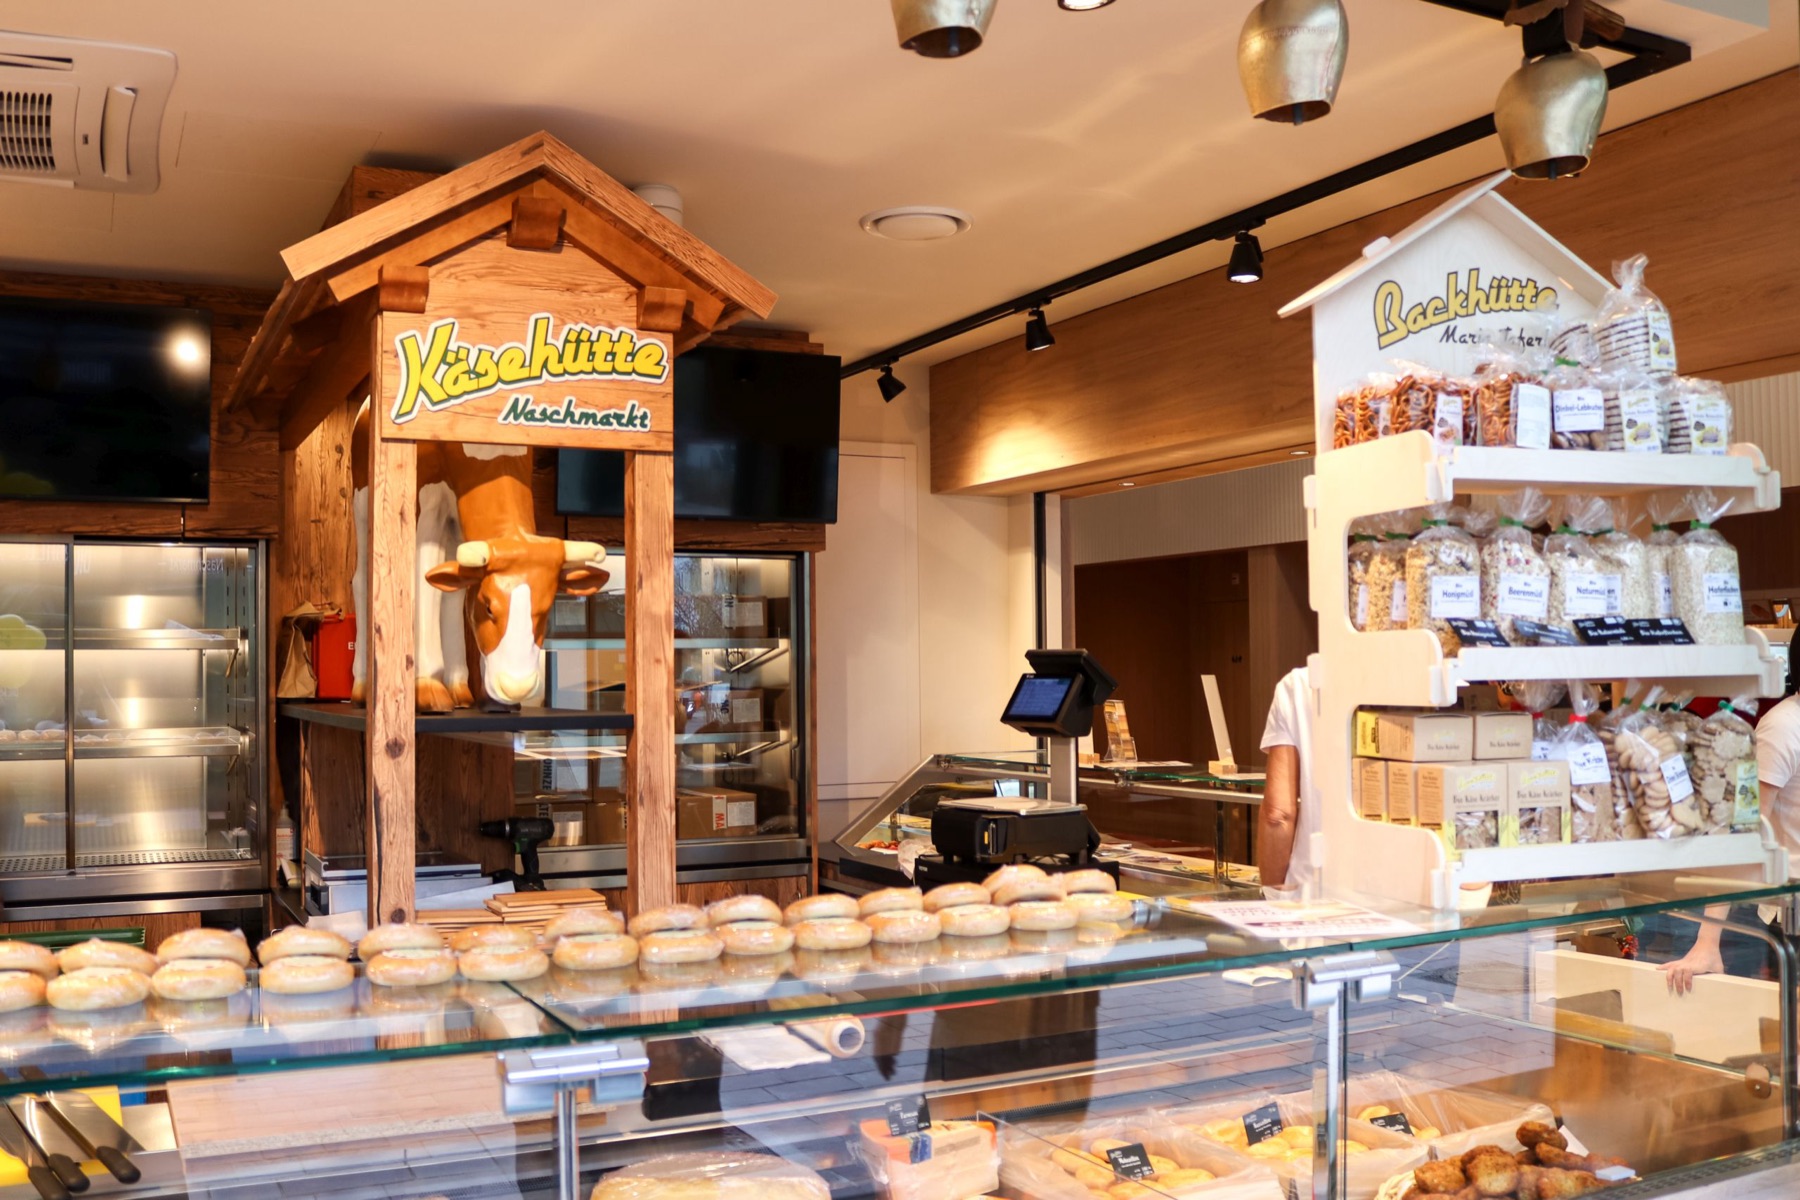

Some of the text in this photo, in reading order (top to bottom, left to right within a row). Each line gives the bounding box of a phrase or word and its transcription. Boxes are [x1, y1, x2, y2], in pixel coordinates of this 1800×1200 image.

[1373, 267, 1560, 350] Backhütte
[394, 316, 667, 421] Käsehütte
[501, 397, 649, 428] Naschmarkt
